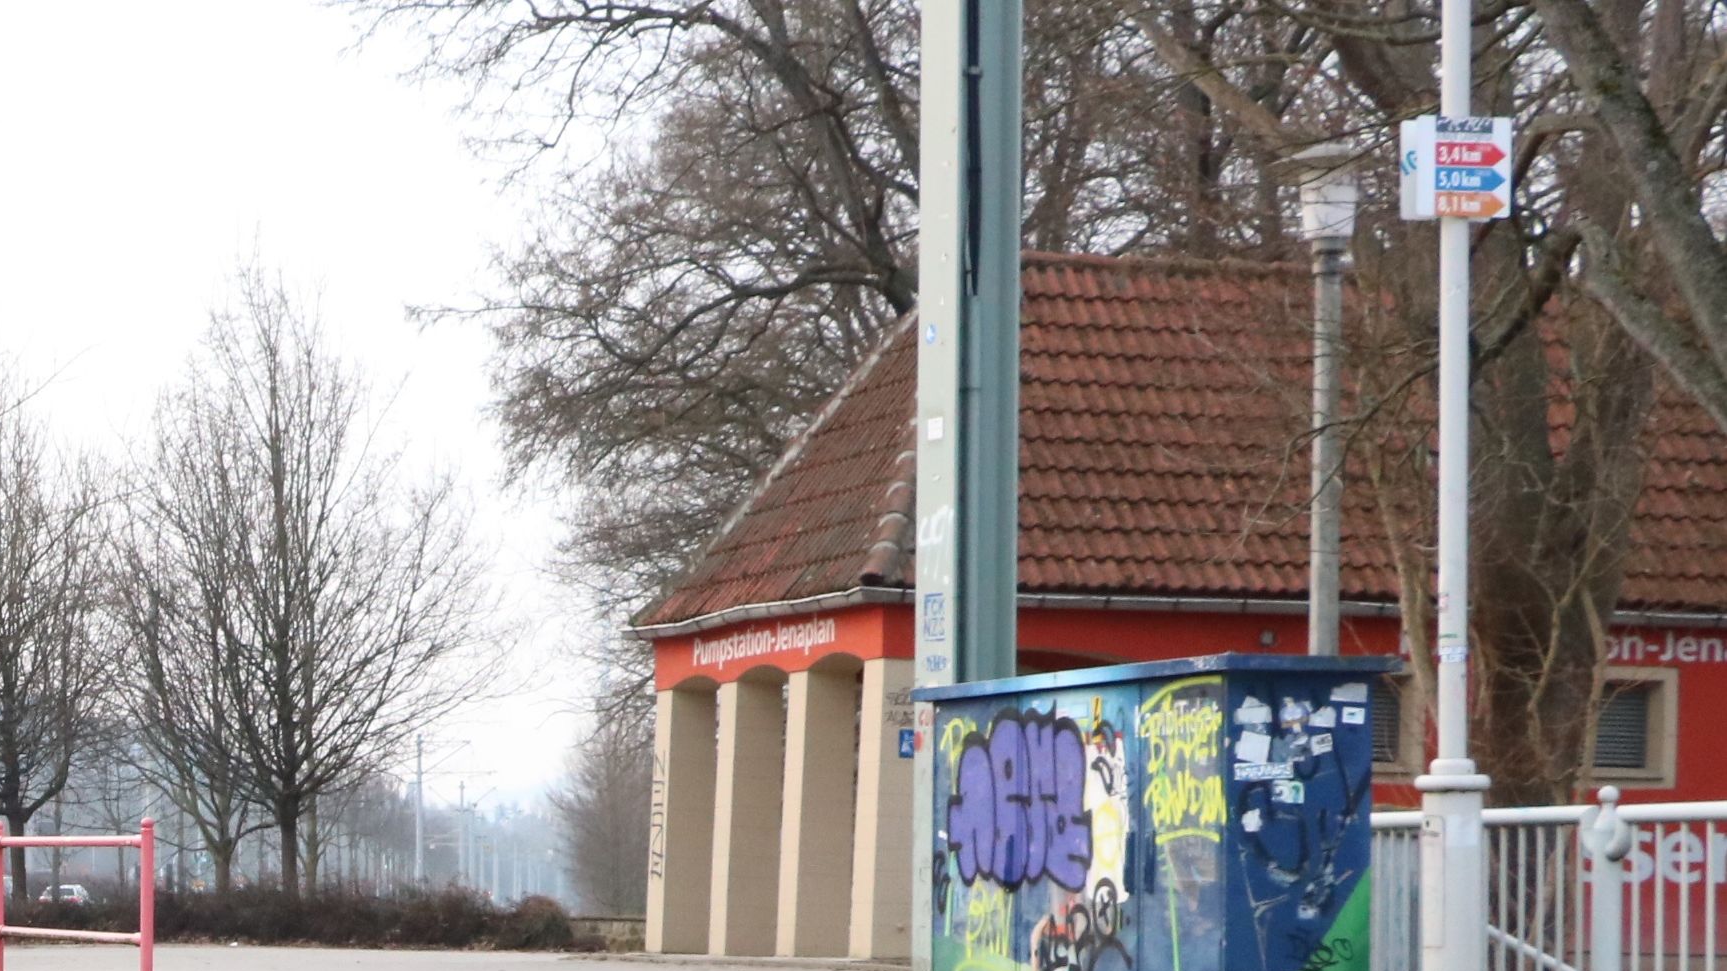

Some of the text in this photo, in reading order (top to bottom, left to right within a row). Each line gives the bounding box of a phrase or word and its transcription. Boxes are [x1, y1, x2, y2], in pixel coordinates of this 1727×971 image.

[1438, 145, 1460, 164] 3,4
[1461, 145, 1482, 162] km
[1438, 169, 1482, 188] 5,0 km
[1460, 195, 1481, 212] km
[692, 616, 836, 670] Pumpstation-Jenaplan
